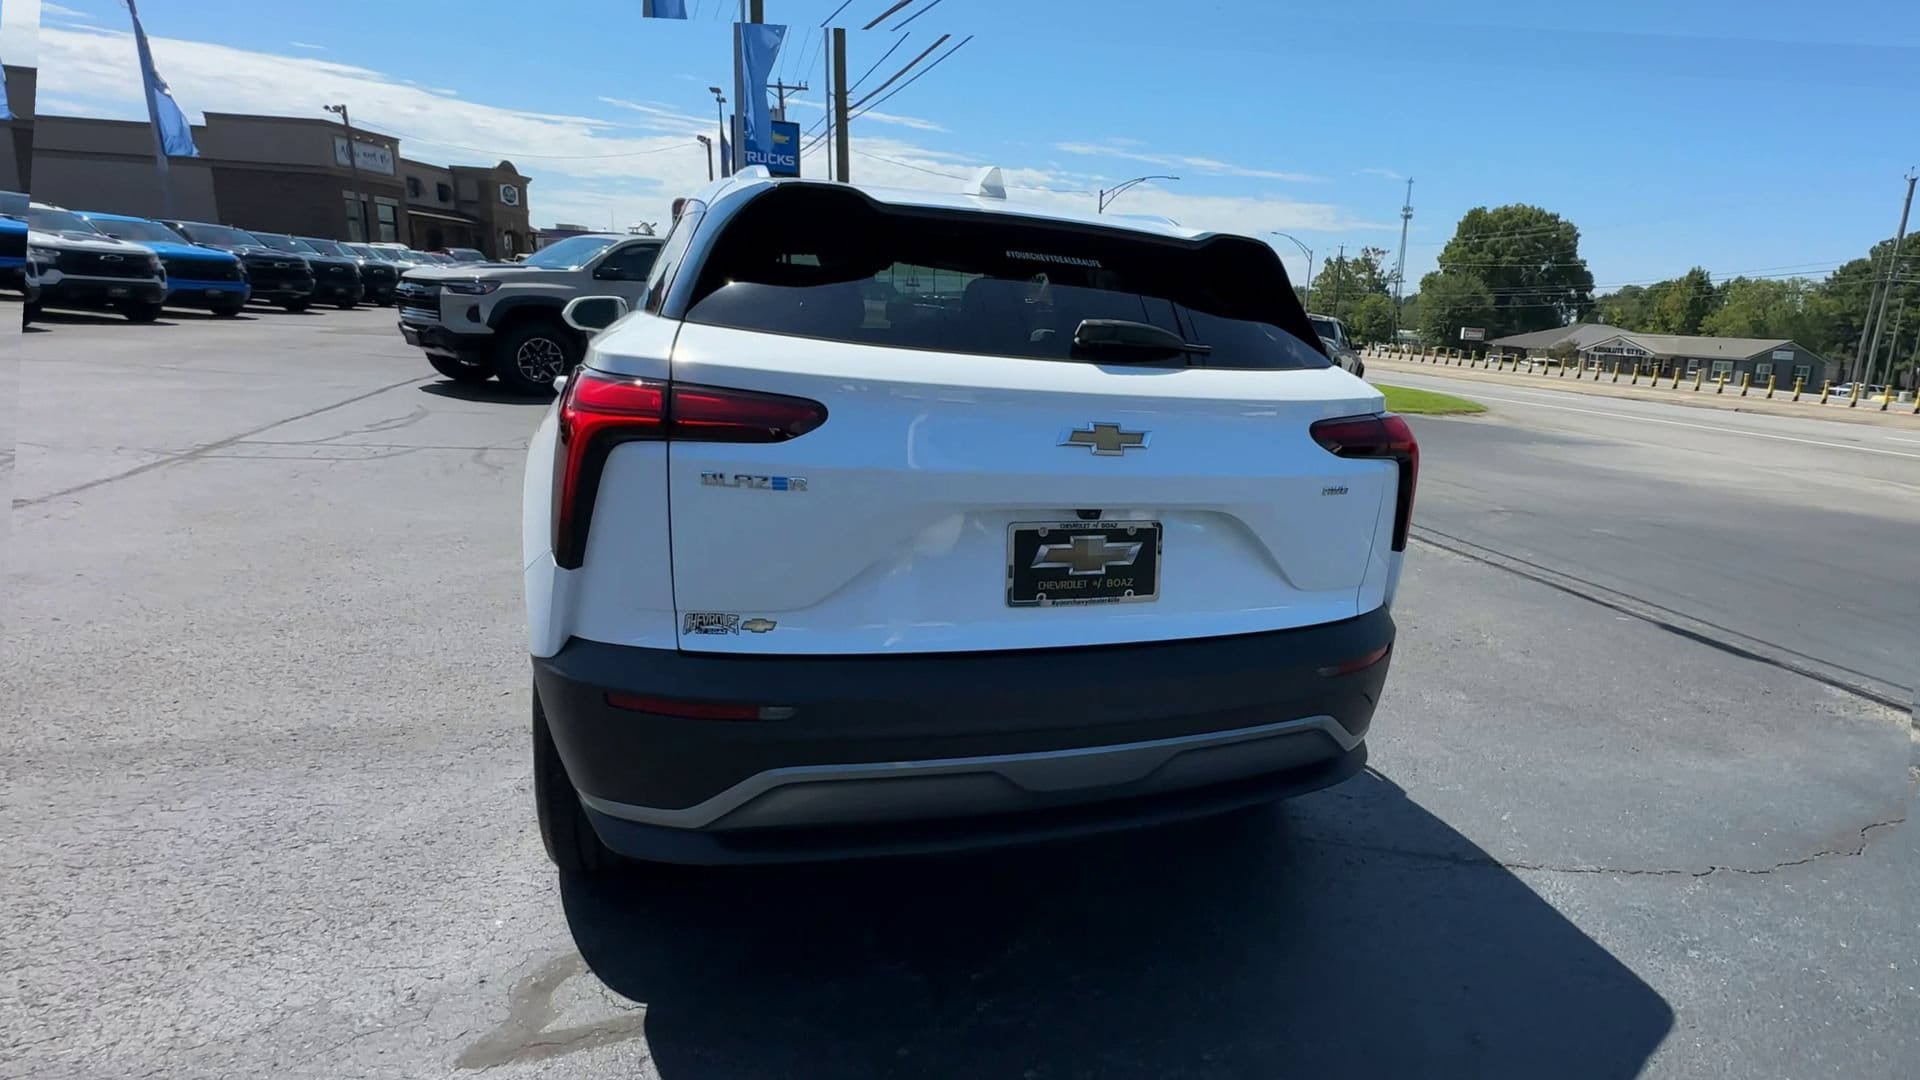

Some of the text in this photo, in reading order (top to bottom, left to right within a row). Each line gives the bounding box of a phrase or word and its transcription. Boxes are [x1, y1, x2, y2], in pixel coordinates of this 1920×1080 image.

[701, 472, 808, 492] BLAZER
[1038, 580, 1088, 590] CHEVROLET
[1106, 578, 1134, 588] BOAZ
